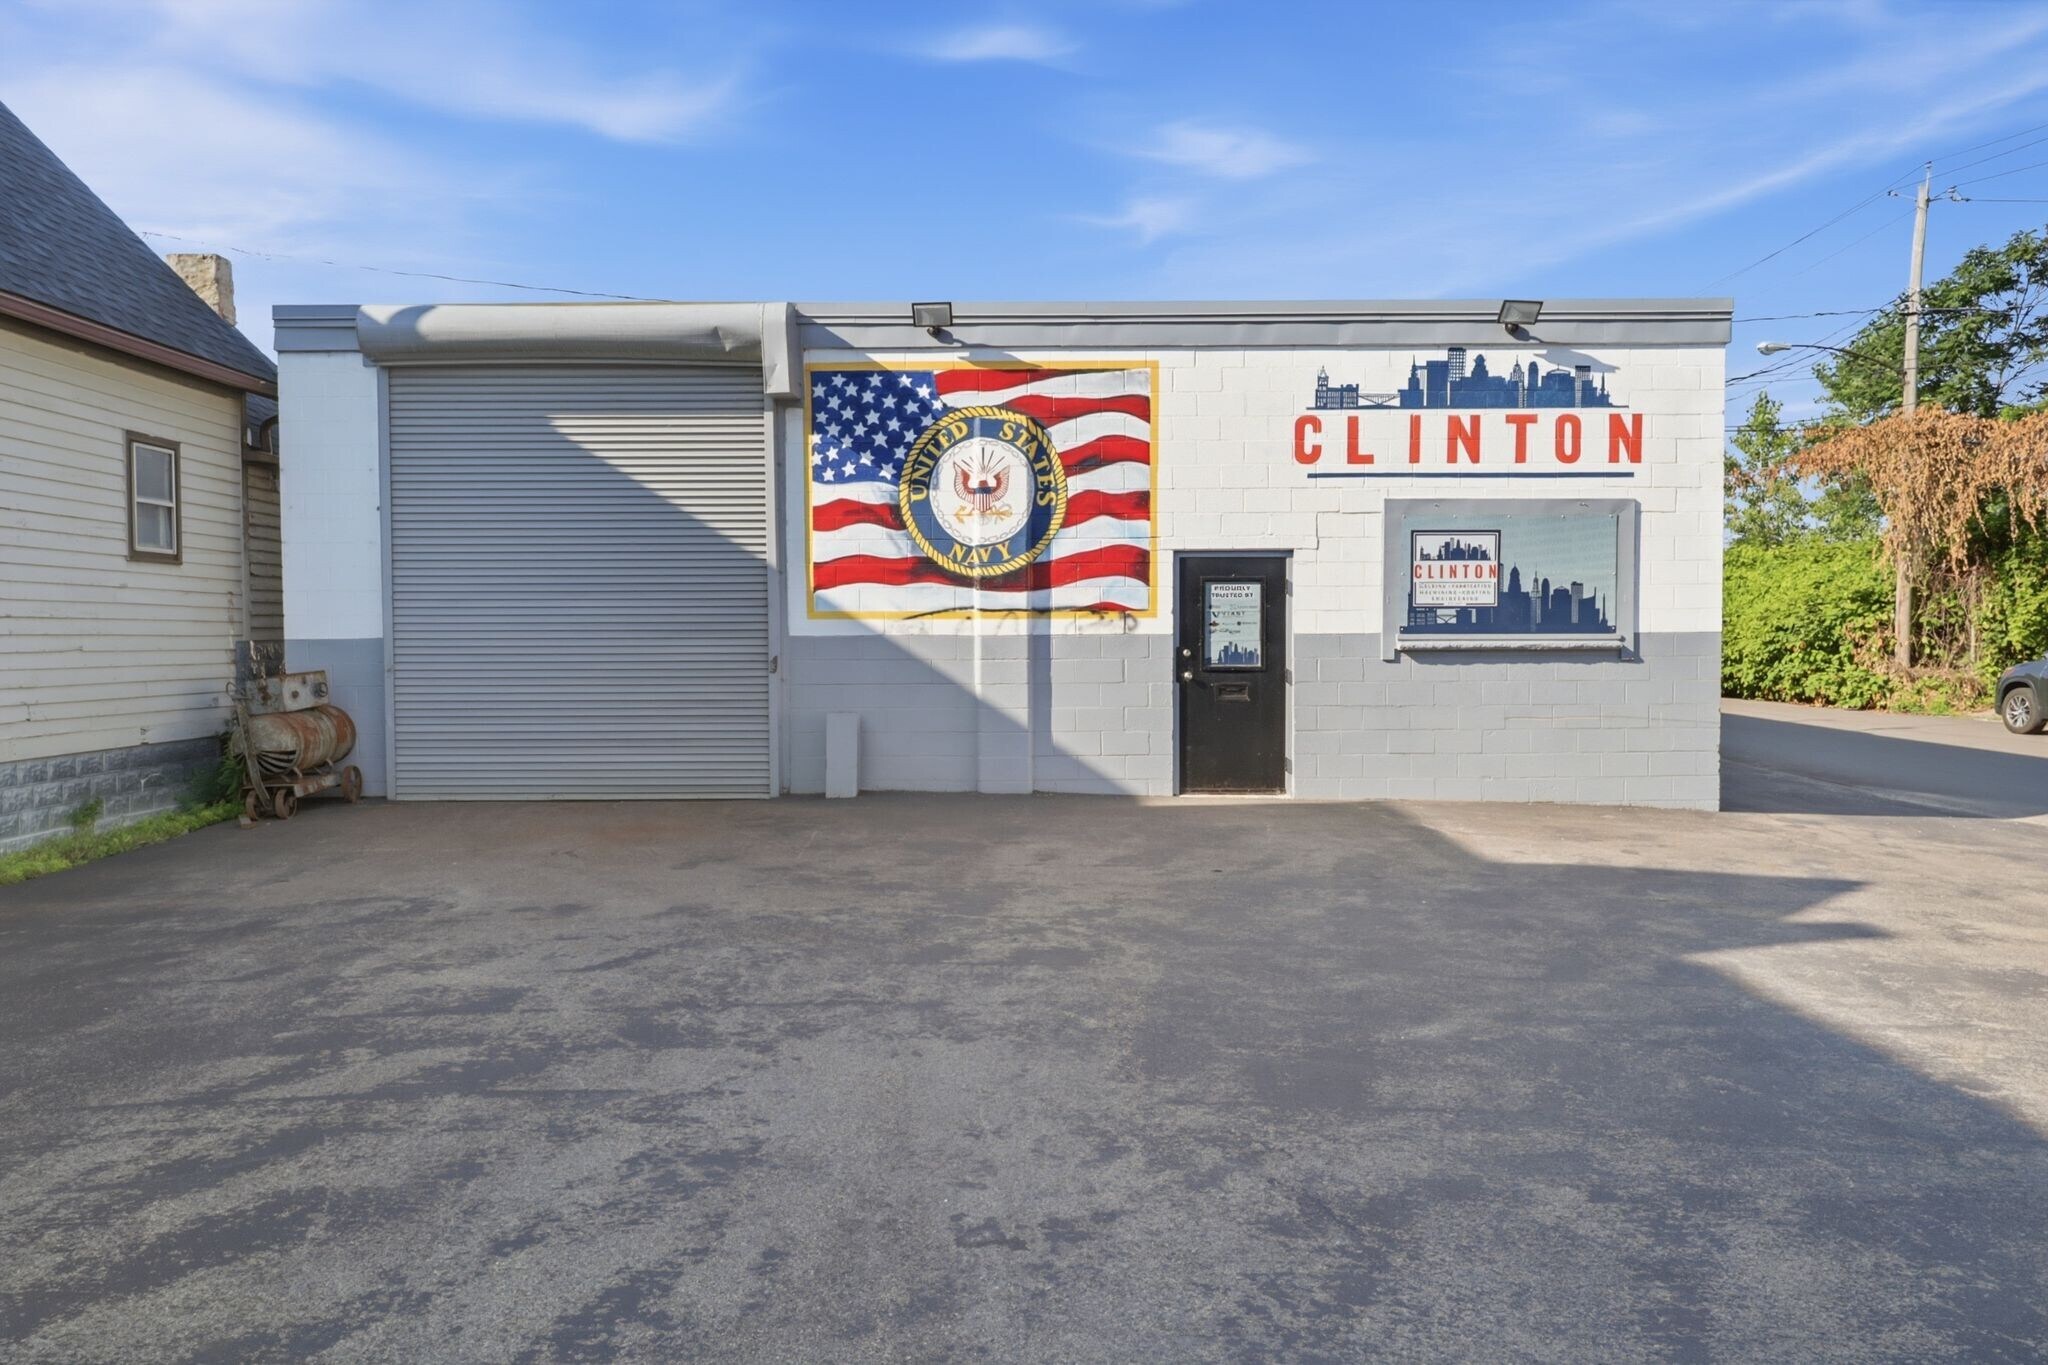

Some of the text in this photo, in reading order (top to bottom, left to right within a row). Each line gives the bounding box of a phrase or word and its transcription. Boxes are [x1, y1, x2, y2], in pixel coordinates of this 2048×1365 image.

[1294, 413, 1643, 465] CLINTON
[910, 422, 1056, 506] UNITED STATES
[950, 542, 1012, 565] NAVY
[1414, 564, 1497, 579] CLINTON
